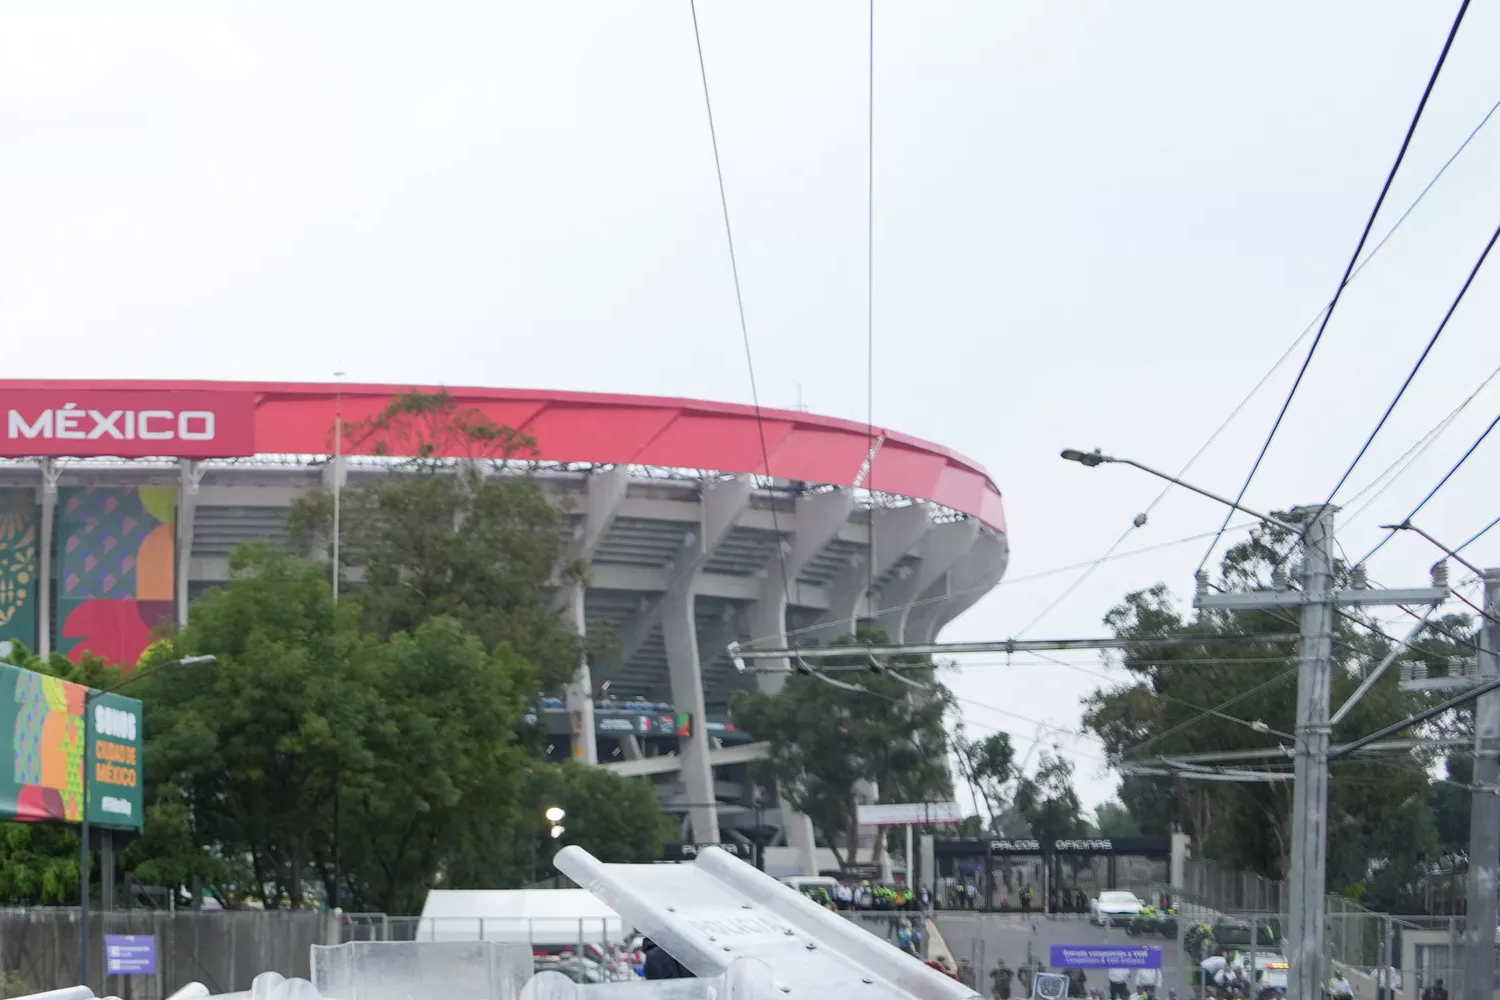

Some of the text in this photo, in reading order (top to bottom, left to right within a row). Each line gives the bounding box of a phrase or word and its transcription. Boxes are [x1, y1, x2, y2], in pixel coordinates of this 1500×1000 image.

[7, 402, 216, 440] MÉXICO
[990, 840, 1040, 850] PALCOS
[1055, 840, 1113, 850] OFICINAS
